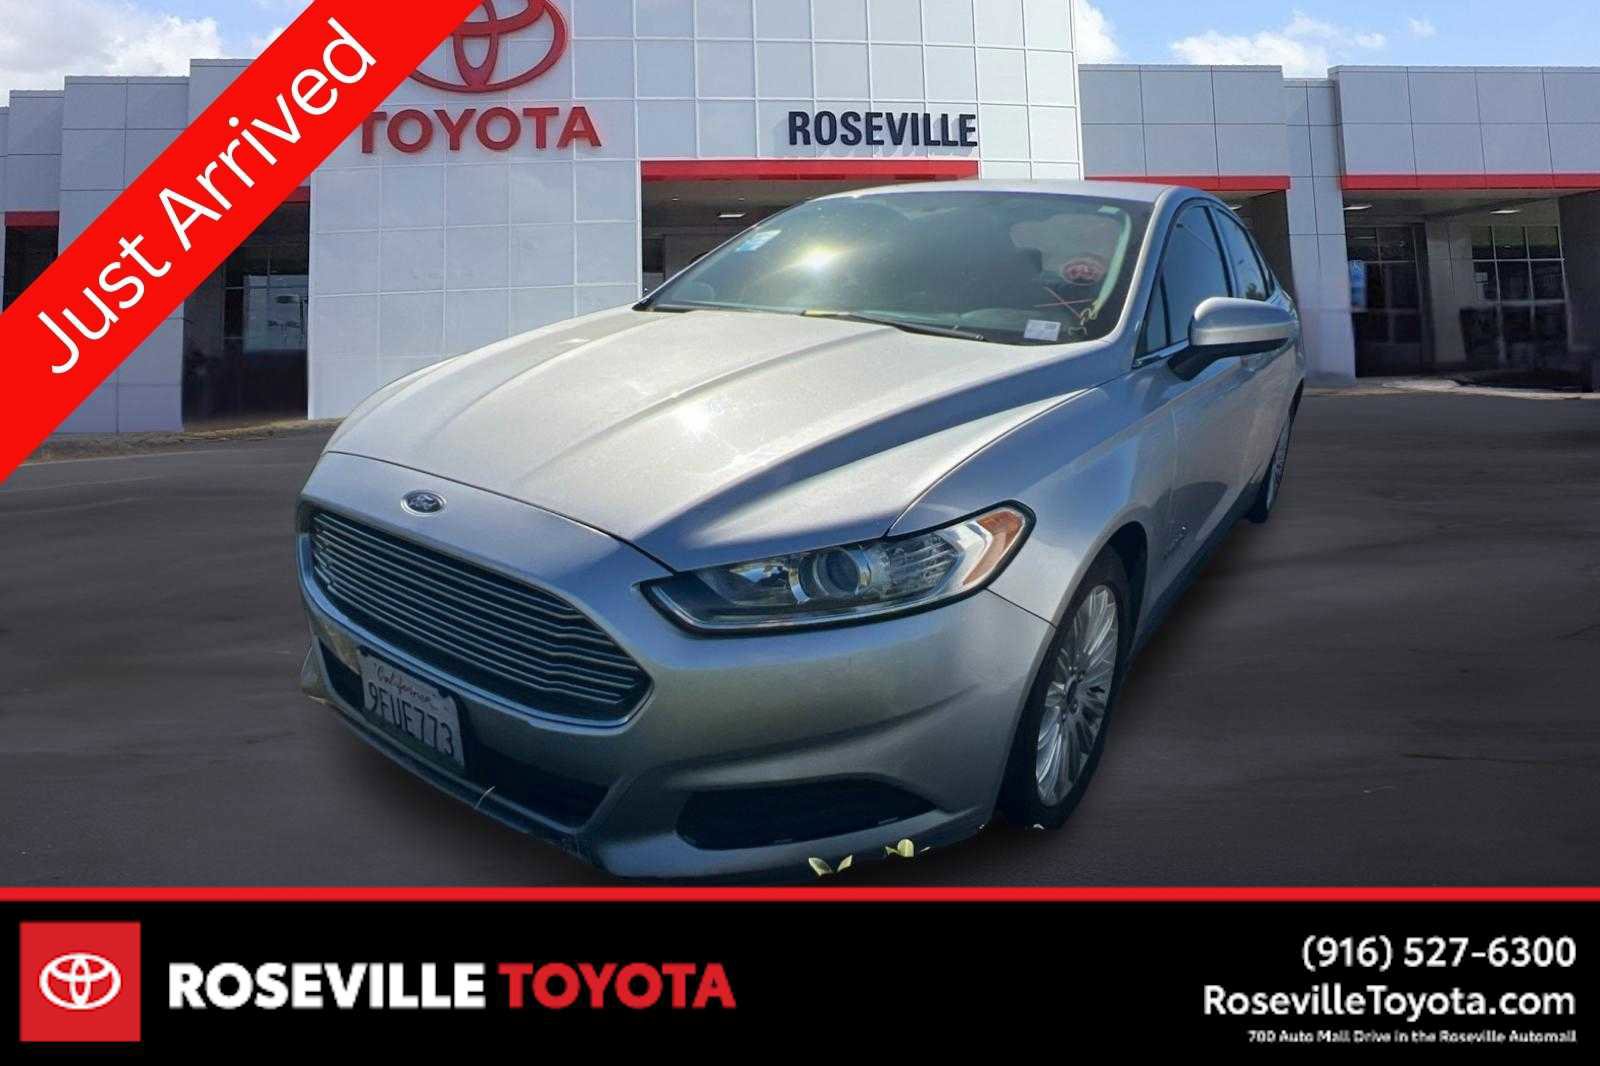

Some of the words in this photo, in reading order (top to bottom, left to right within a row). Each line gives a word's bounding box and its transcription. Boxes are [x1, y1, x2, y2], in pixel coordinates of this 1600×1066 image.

[361, 107, 602, 154] TOYOTA
[788, 110, 978, 147] ROSEVILLE
[367, 681, 455, 758] 9FUE773
